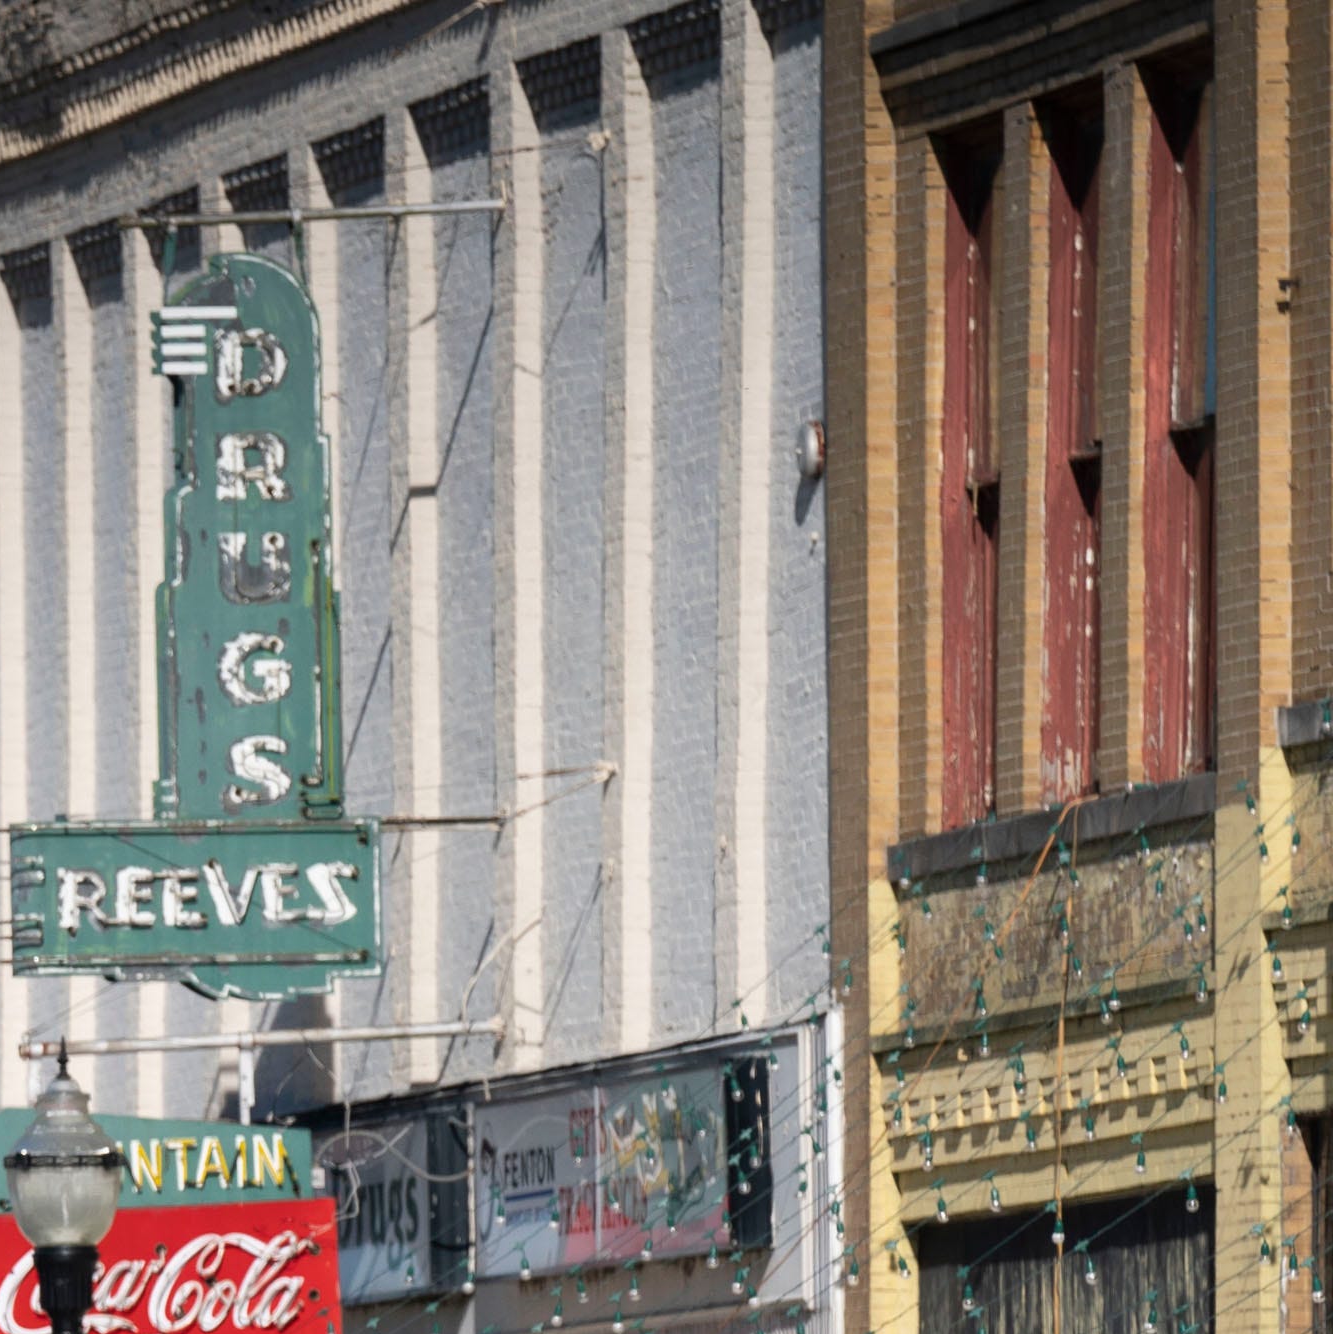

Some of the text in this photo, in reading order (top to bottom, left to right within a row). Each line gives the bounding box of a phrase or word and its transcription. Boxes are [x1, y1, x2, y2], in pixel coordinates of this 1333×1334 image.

[214, 328, 291, 807] DRUGS
[56, 859, 359, 931] REEVES
[116, 1132, 286, 1194] NTAIN
[503, 1146, 556, 1188] FENTON
